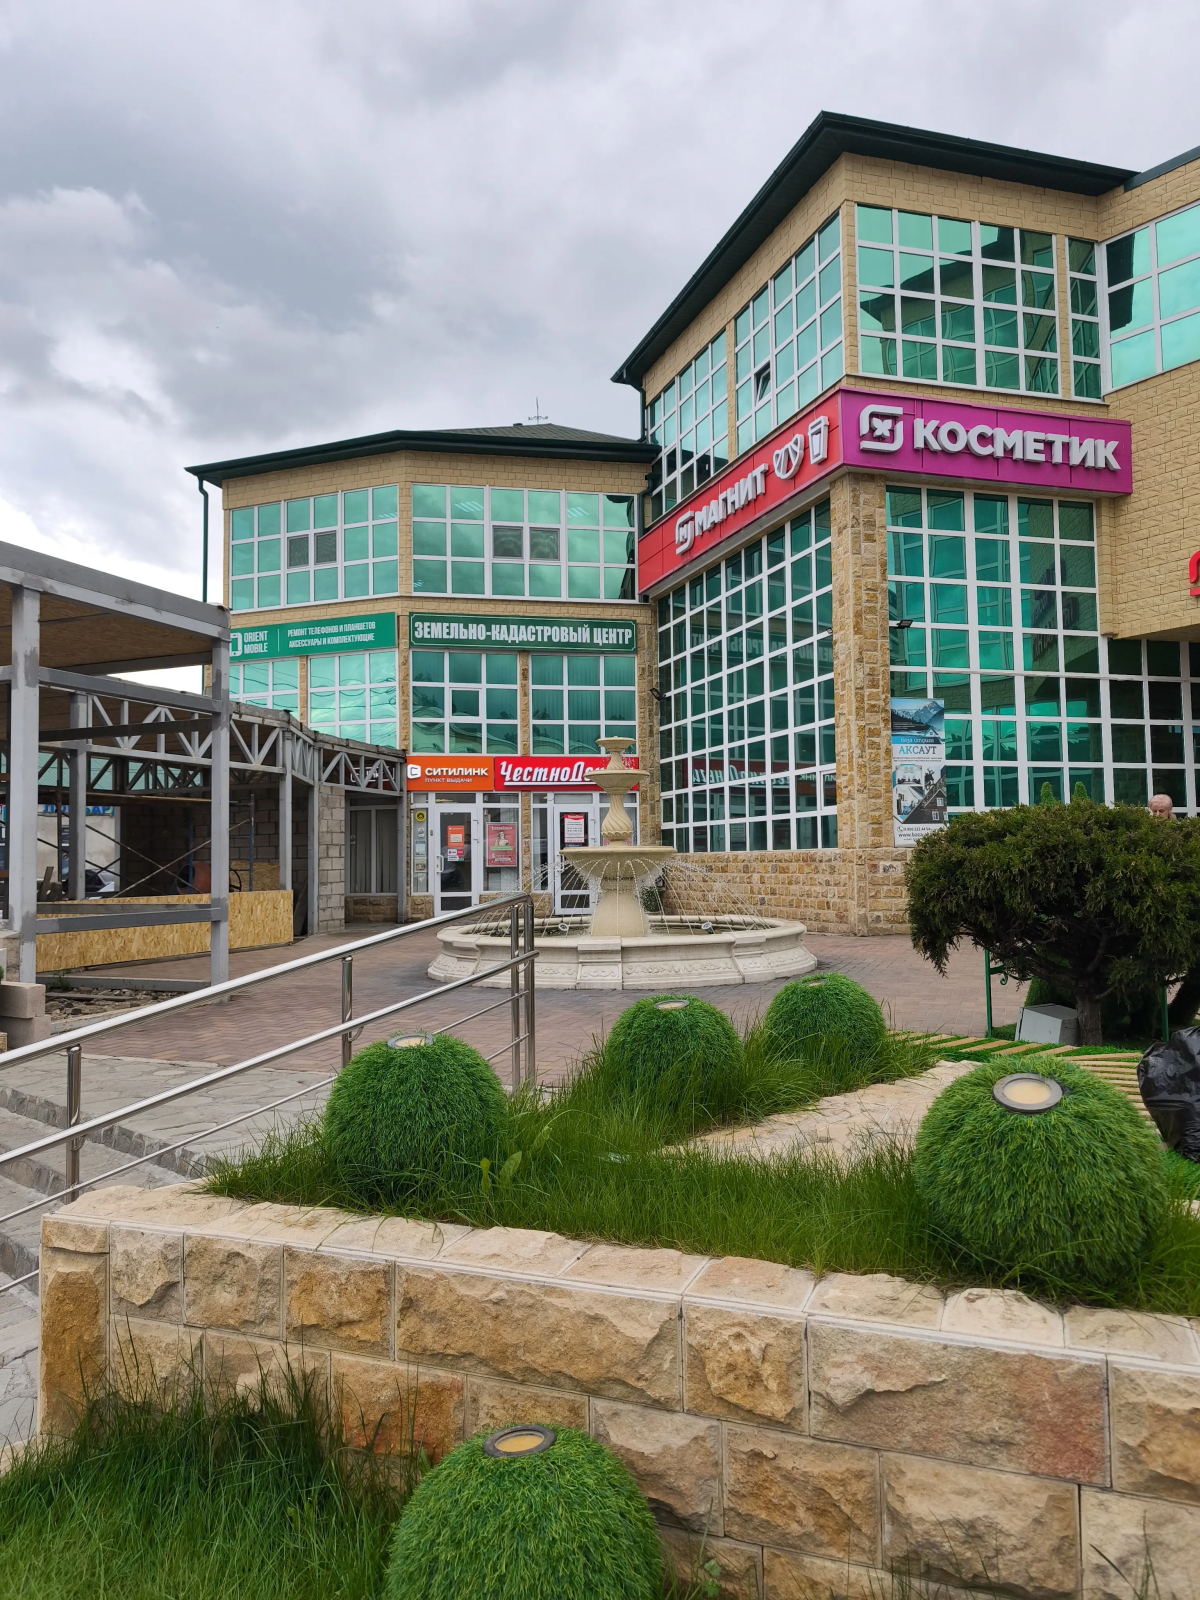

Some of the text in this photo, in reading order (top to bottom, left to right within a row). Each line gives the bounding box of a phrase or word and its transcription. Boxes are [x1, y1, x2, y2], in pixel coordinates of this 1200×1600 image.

[913, 417, 1121, 471] КОСМЕТИК
[694, 463, 769, 537] МАГНИТ
[243, 630, 268, 643] ORIENT
[287, 621, 376, 638] РЕМОНТ ТЕЛЕФОНОВ И ПЛАНШЕТОВ
[414, 621, 633, 646] ЗЕМЕЛЬНО-КАДАСТРОВЫЙ ЦЕНТР
[288, 633, 375, 648] АКСЕССУАРЫ И КОМПЛЕКТУЮЩИЕ
[243, 643, 268, 654] MOBILE
[898, 745, 937, 754] АКСАУТ
[424, 767, 489, 776] СИТИЛИНК
